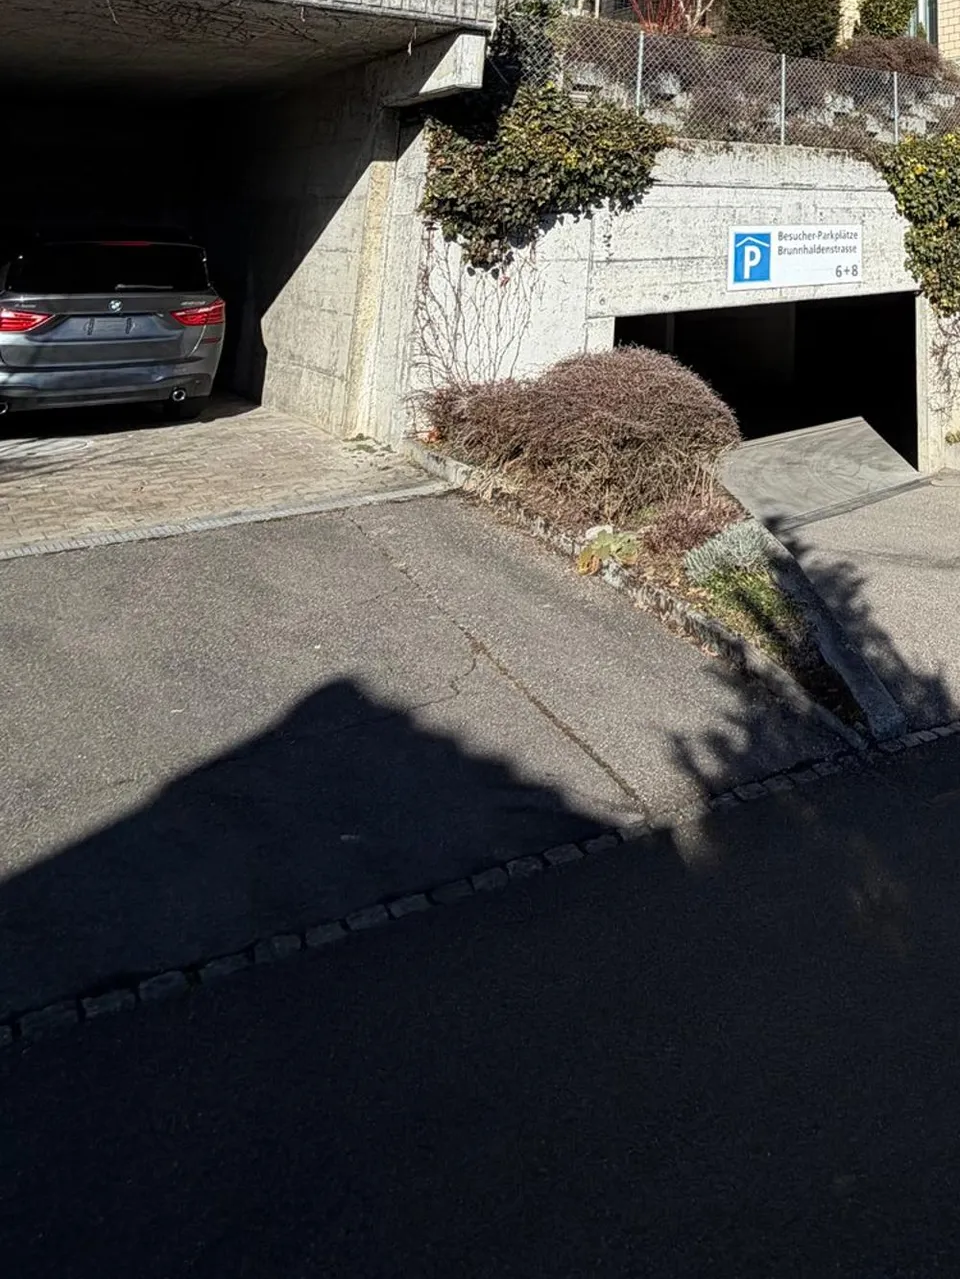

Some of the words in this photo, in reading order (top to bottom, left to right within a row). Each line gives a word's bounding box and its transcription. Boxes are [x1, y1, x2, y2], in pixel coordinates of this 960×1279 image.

[777, 231, 858, 241] Besucher-Parkplätze
[777, 244, 857, 256] Brunnhaldenstrasse
[744, 245, 761, 280] P
